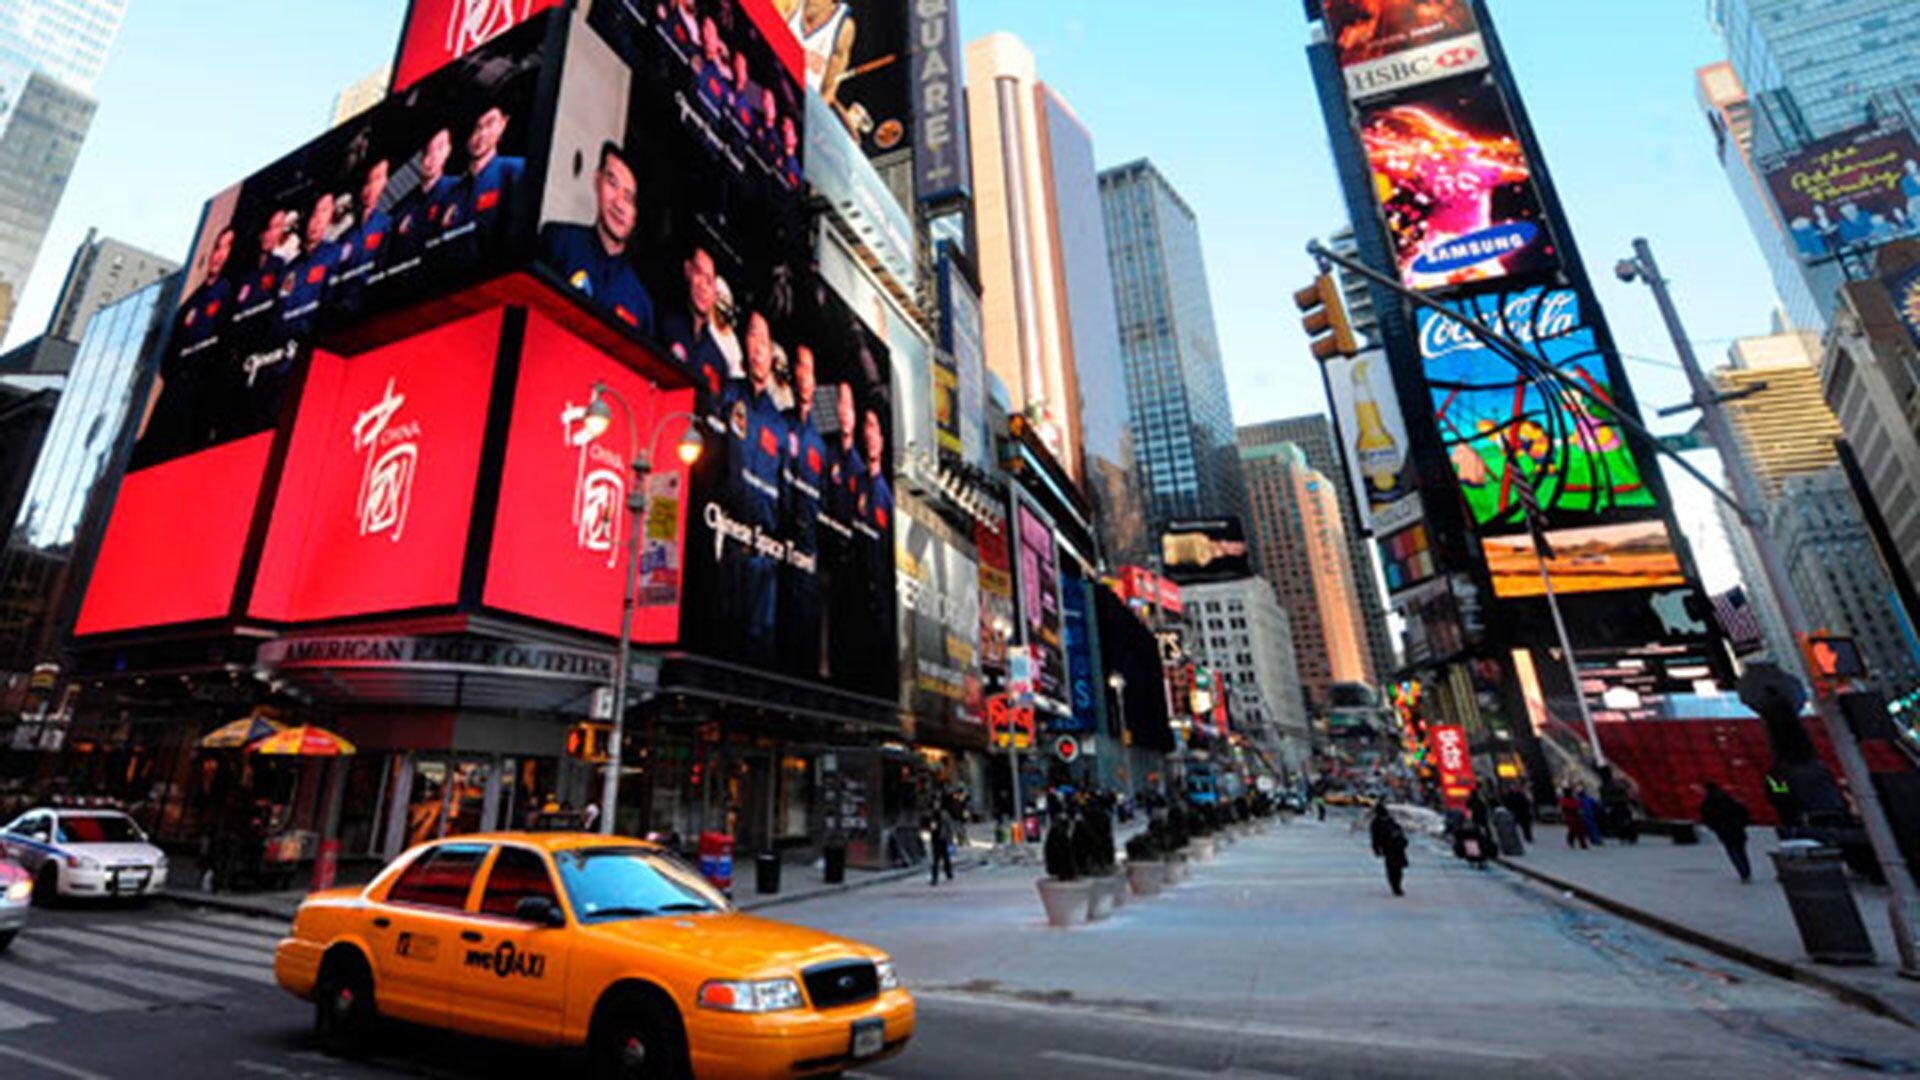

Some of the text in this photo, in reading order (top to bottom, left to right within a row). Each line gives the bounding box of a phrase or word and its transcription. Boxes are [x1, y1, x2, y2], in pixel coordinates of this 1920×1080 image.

[1352, 56, 1430, 90] HSBC
[1426, 234, 1524, 264] SAMSUNG
[703, 501, 753, 562] Chinese
[754, 525, 784, 559] Space
[786, 540, 817, 574] Travel
[286, 639, 405, 662] AMERICAN
[411, 640, 498, 664] EAGLE
